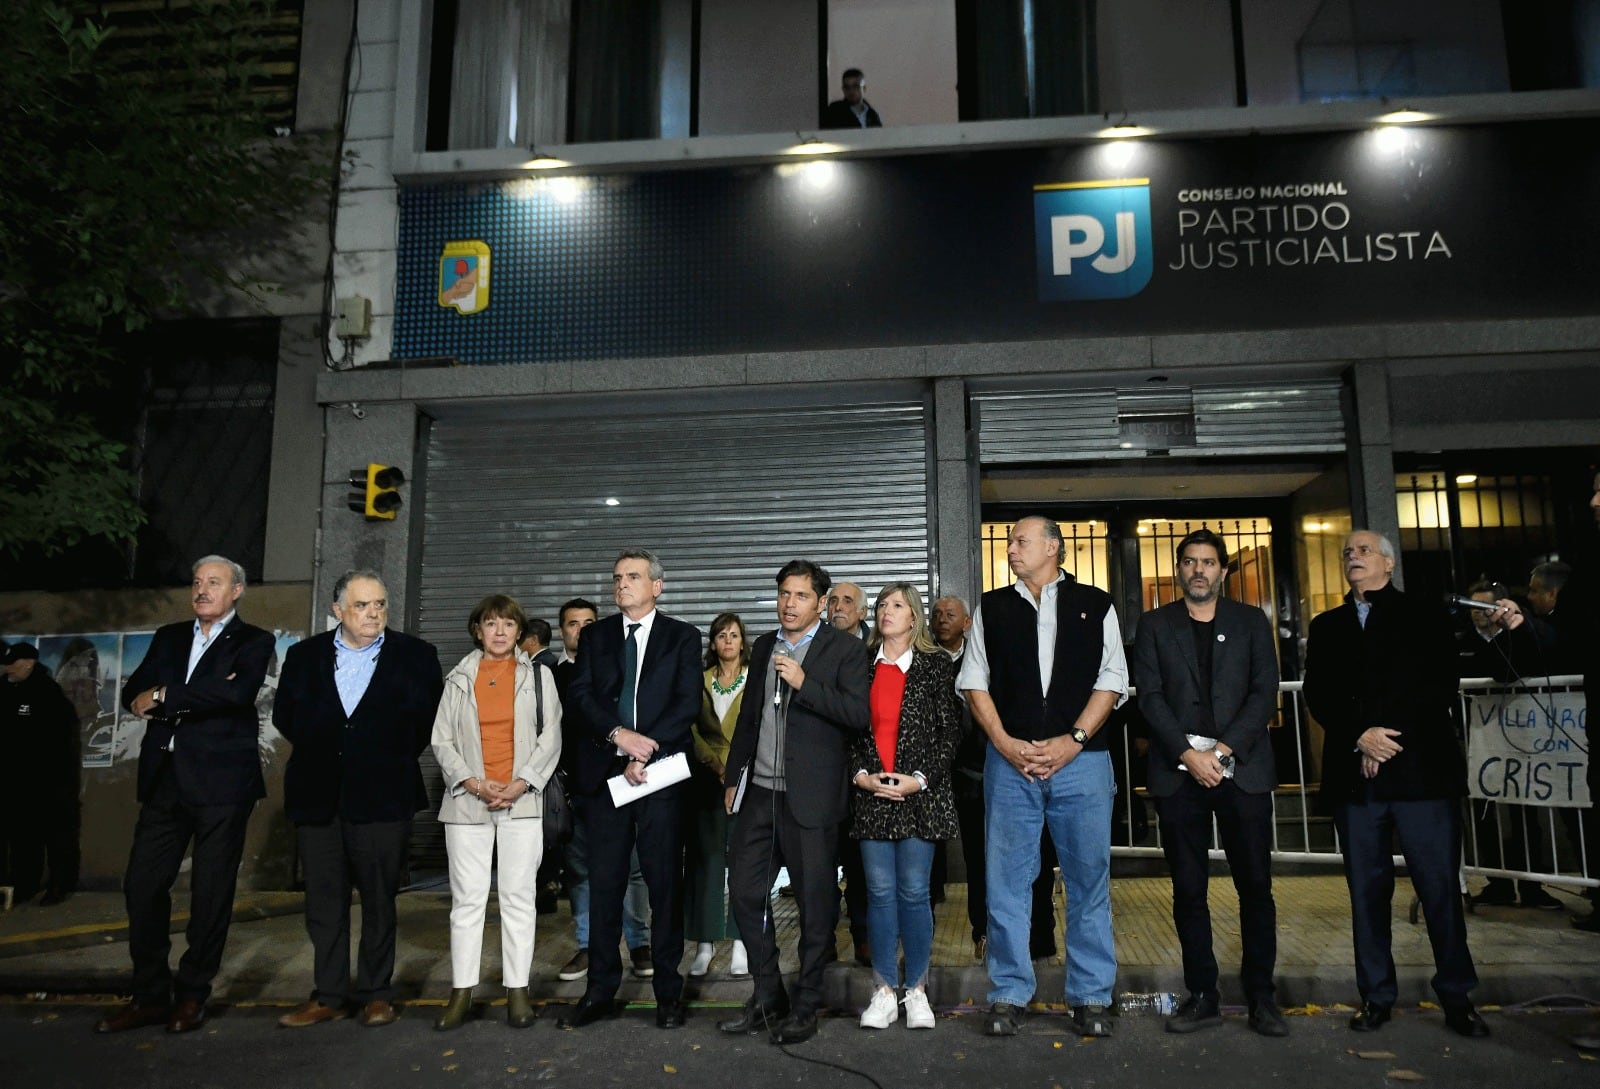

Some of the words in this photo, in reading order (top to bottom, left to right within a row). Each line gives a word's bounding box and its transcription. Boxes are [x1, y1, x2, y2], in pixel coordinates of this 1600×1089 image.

[1178, 188, 1255, 203] CONSEJO
[1260, 181, 1348, 199] NACIONAL
[1179, 200, 1350, 237] PARTIDO
[1051, 211, 1136, 276] PJ
[1169, 230, 1452, 271] JUSTICIALISTA
[1478, 703, 1536, 729] VILLA
[1533, 737, 1569, 752] CON
